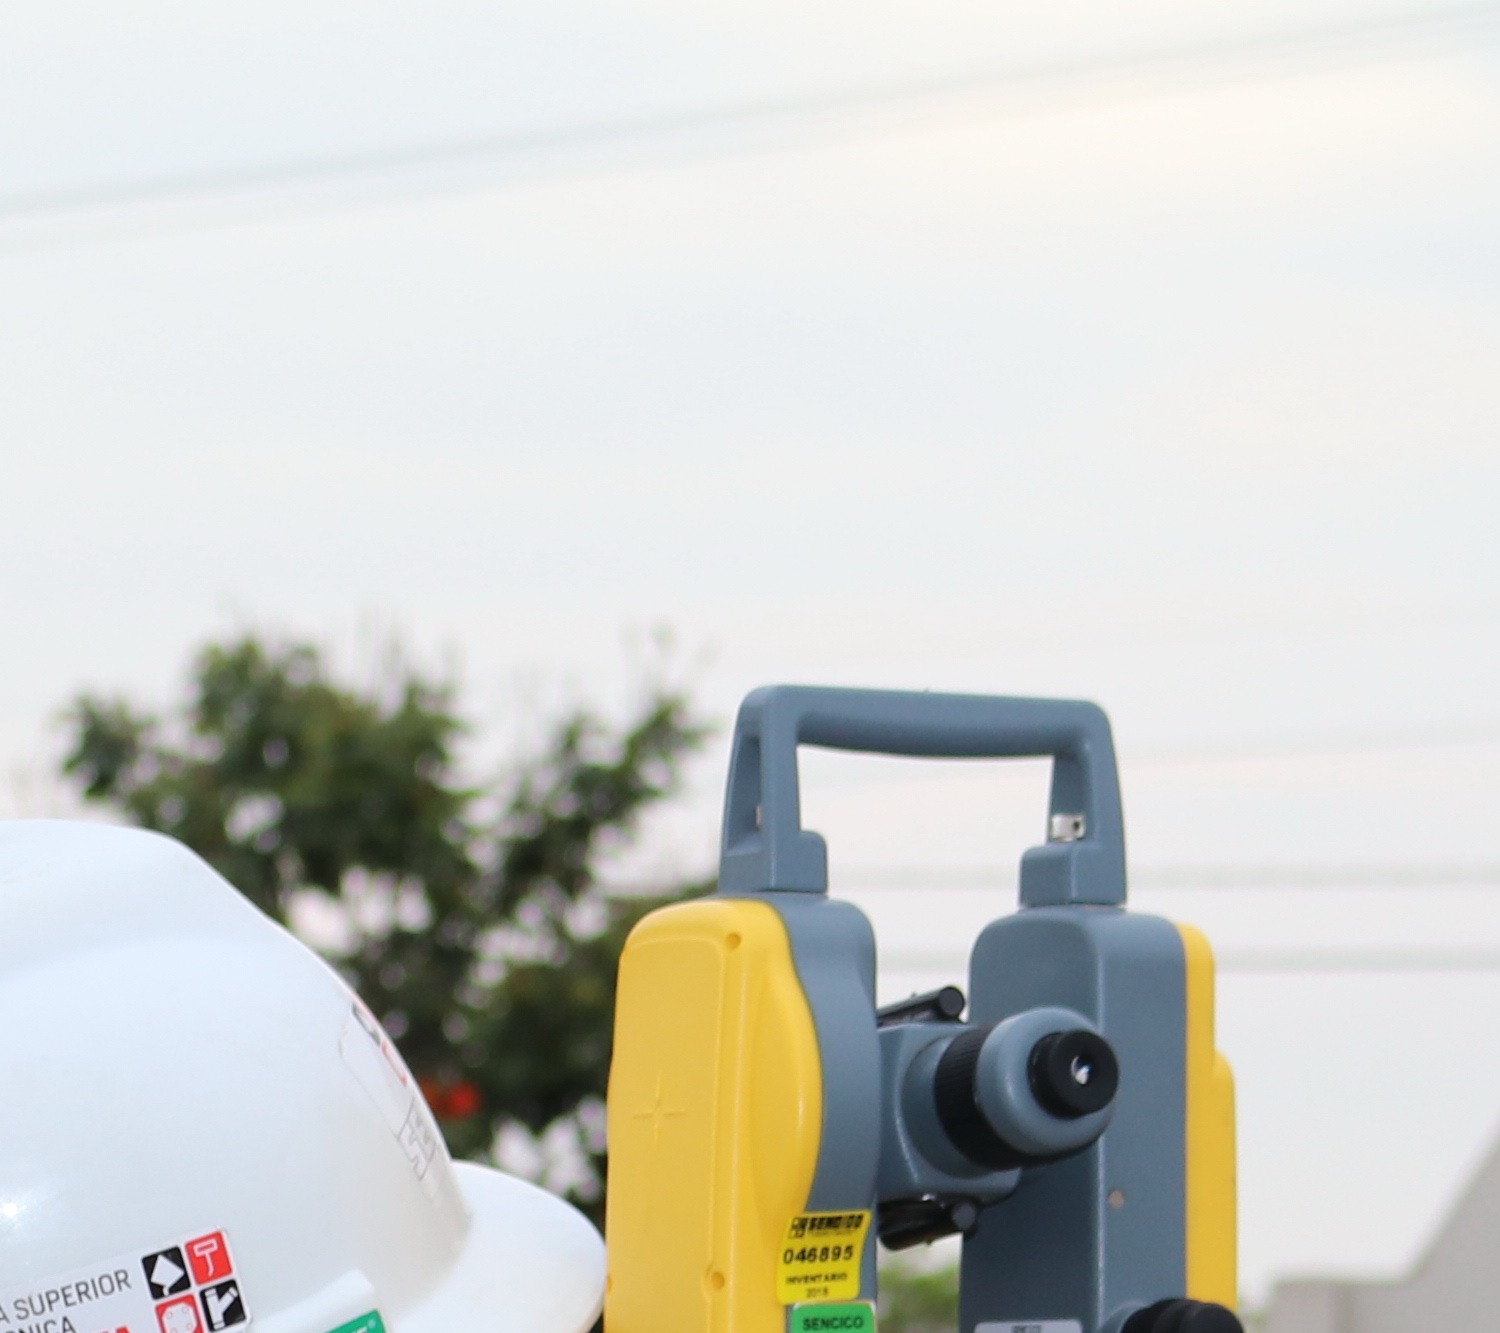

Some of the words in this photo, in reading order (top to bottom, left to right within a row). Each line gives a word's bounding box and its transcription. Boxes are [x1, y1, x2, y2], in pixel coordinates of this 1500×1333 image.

[783, 1245, 854, 1264] 046895
[13, 1269, 132, 1321] SUPERIOR
[803, 1316, 864, 1331] SENCICO
